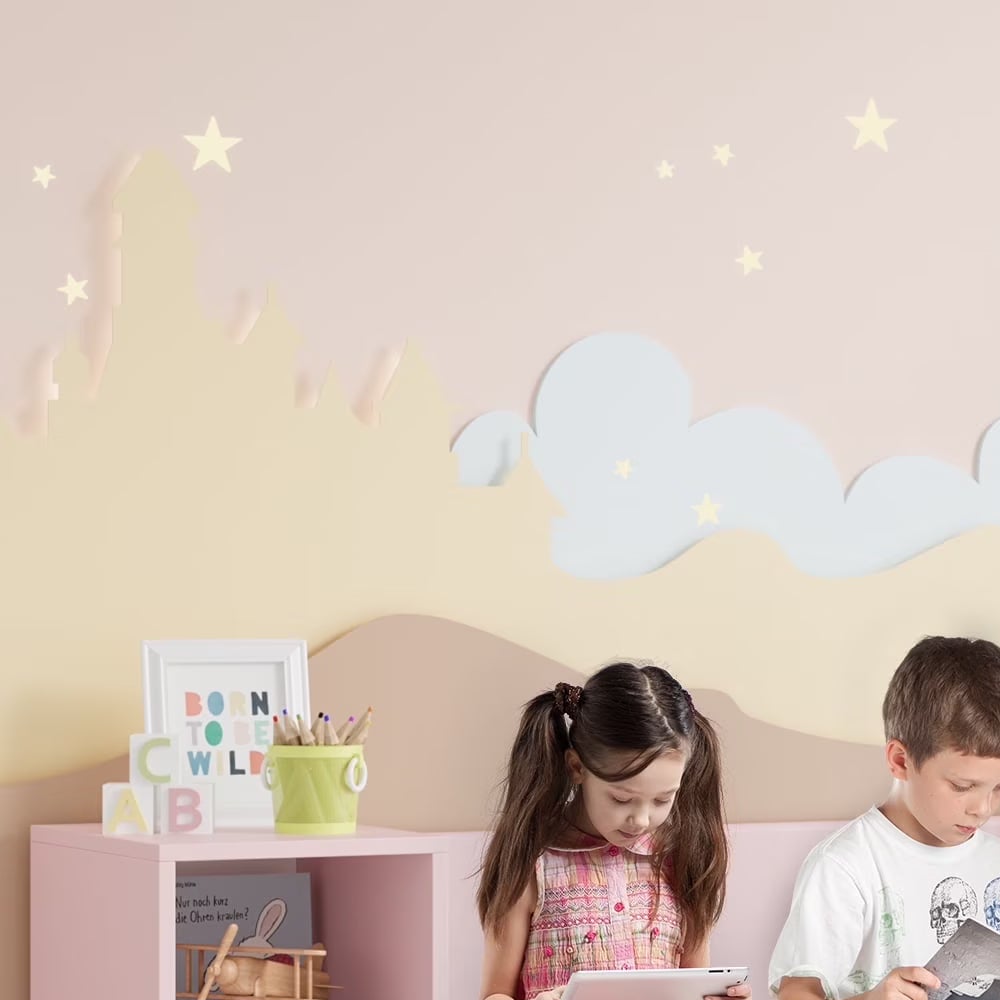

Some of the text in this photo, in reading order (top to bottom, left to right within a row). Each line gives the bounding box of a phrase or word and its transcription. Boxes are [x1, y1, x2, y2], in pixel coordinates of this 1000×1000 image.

[184, 691, 270, 717] BORN
[186, 720, 271, 746] TO BE
[137, 738, 172, 784] C
[187, 750, 265, 776] WILD
[108, 787, 149, 834] A
[167, 787, 203, 833] B
[176, 896, 229, 908] Nur noch kurz
[176, 907, 249, 923] die Ohren kraulen?
